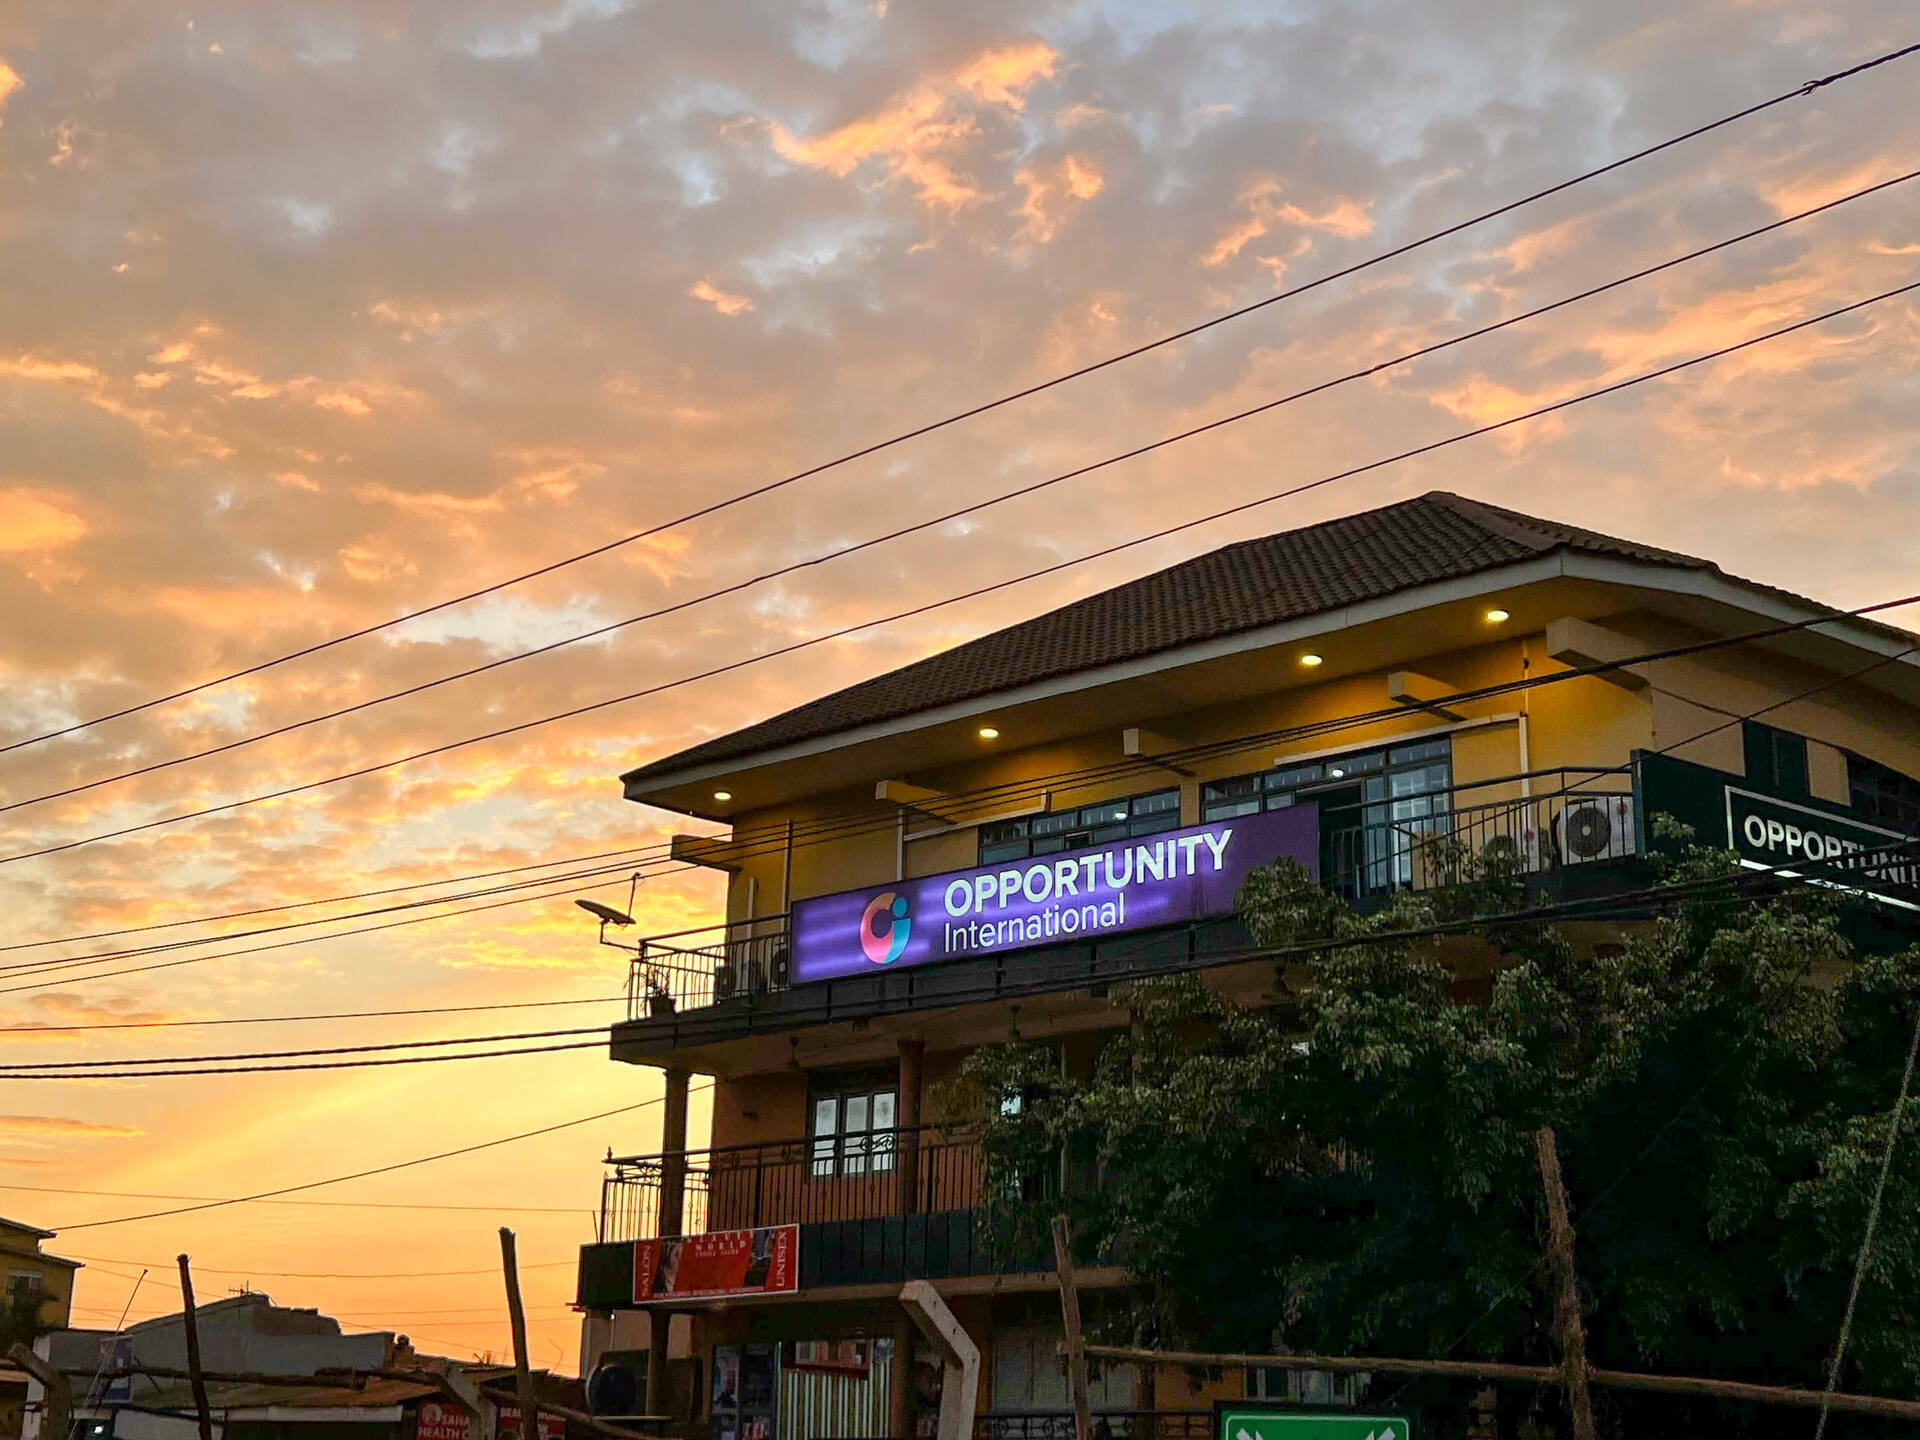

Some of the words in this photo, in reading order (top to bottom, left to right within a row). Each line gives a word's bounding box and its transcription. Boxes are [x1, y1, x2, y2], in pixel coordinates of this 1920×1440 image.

[944, 829, 1233, 917] OPPORTUNITY
[1744, 814, 1920, 889] OPPORTUNIT
[944, 893, 1126, 953] International
[776, 1231, 787, 1288] UNISEX
